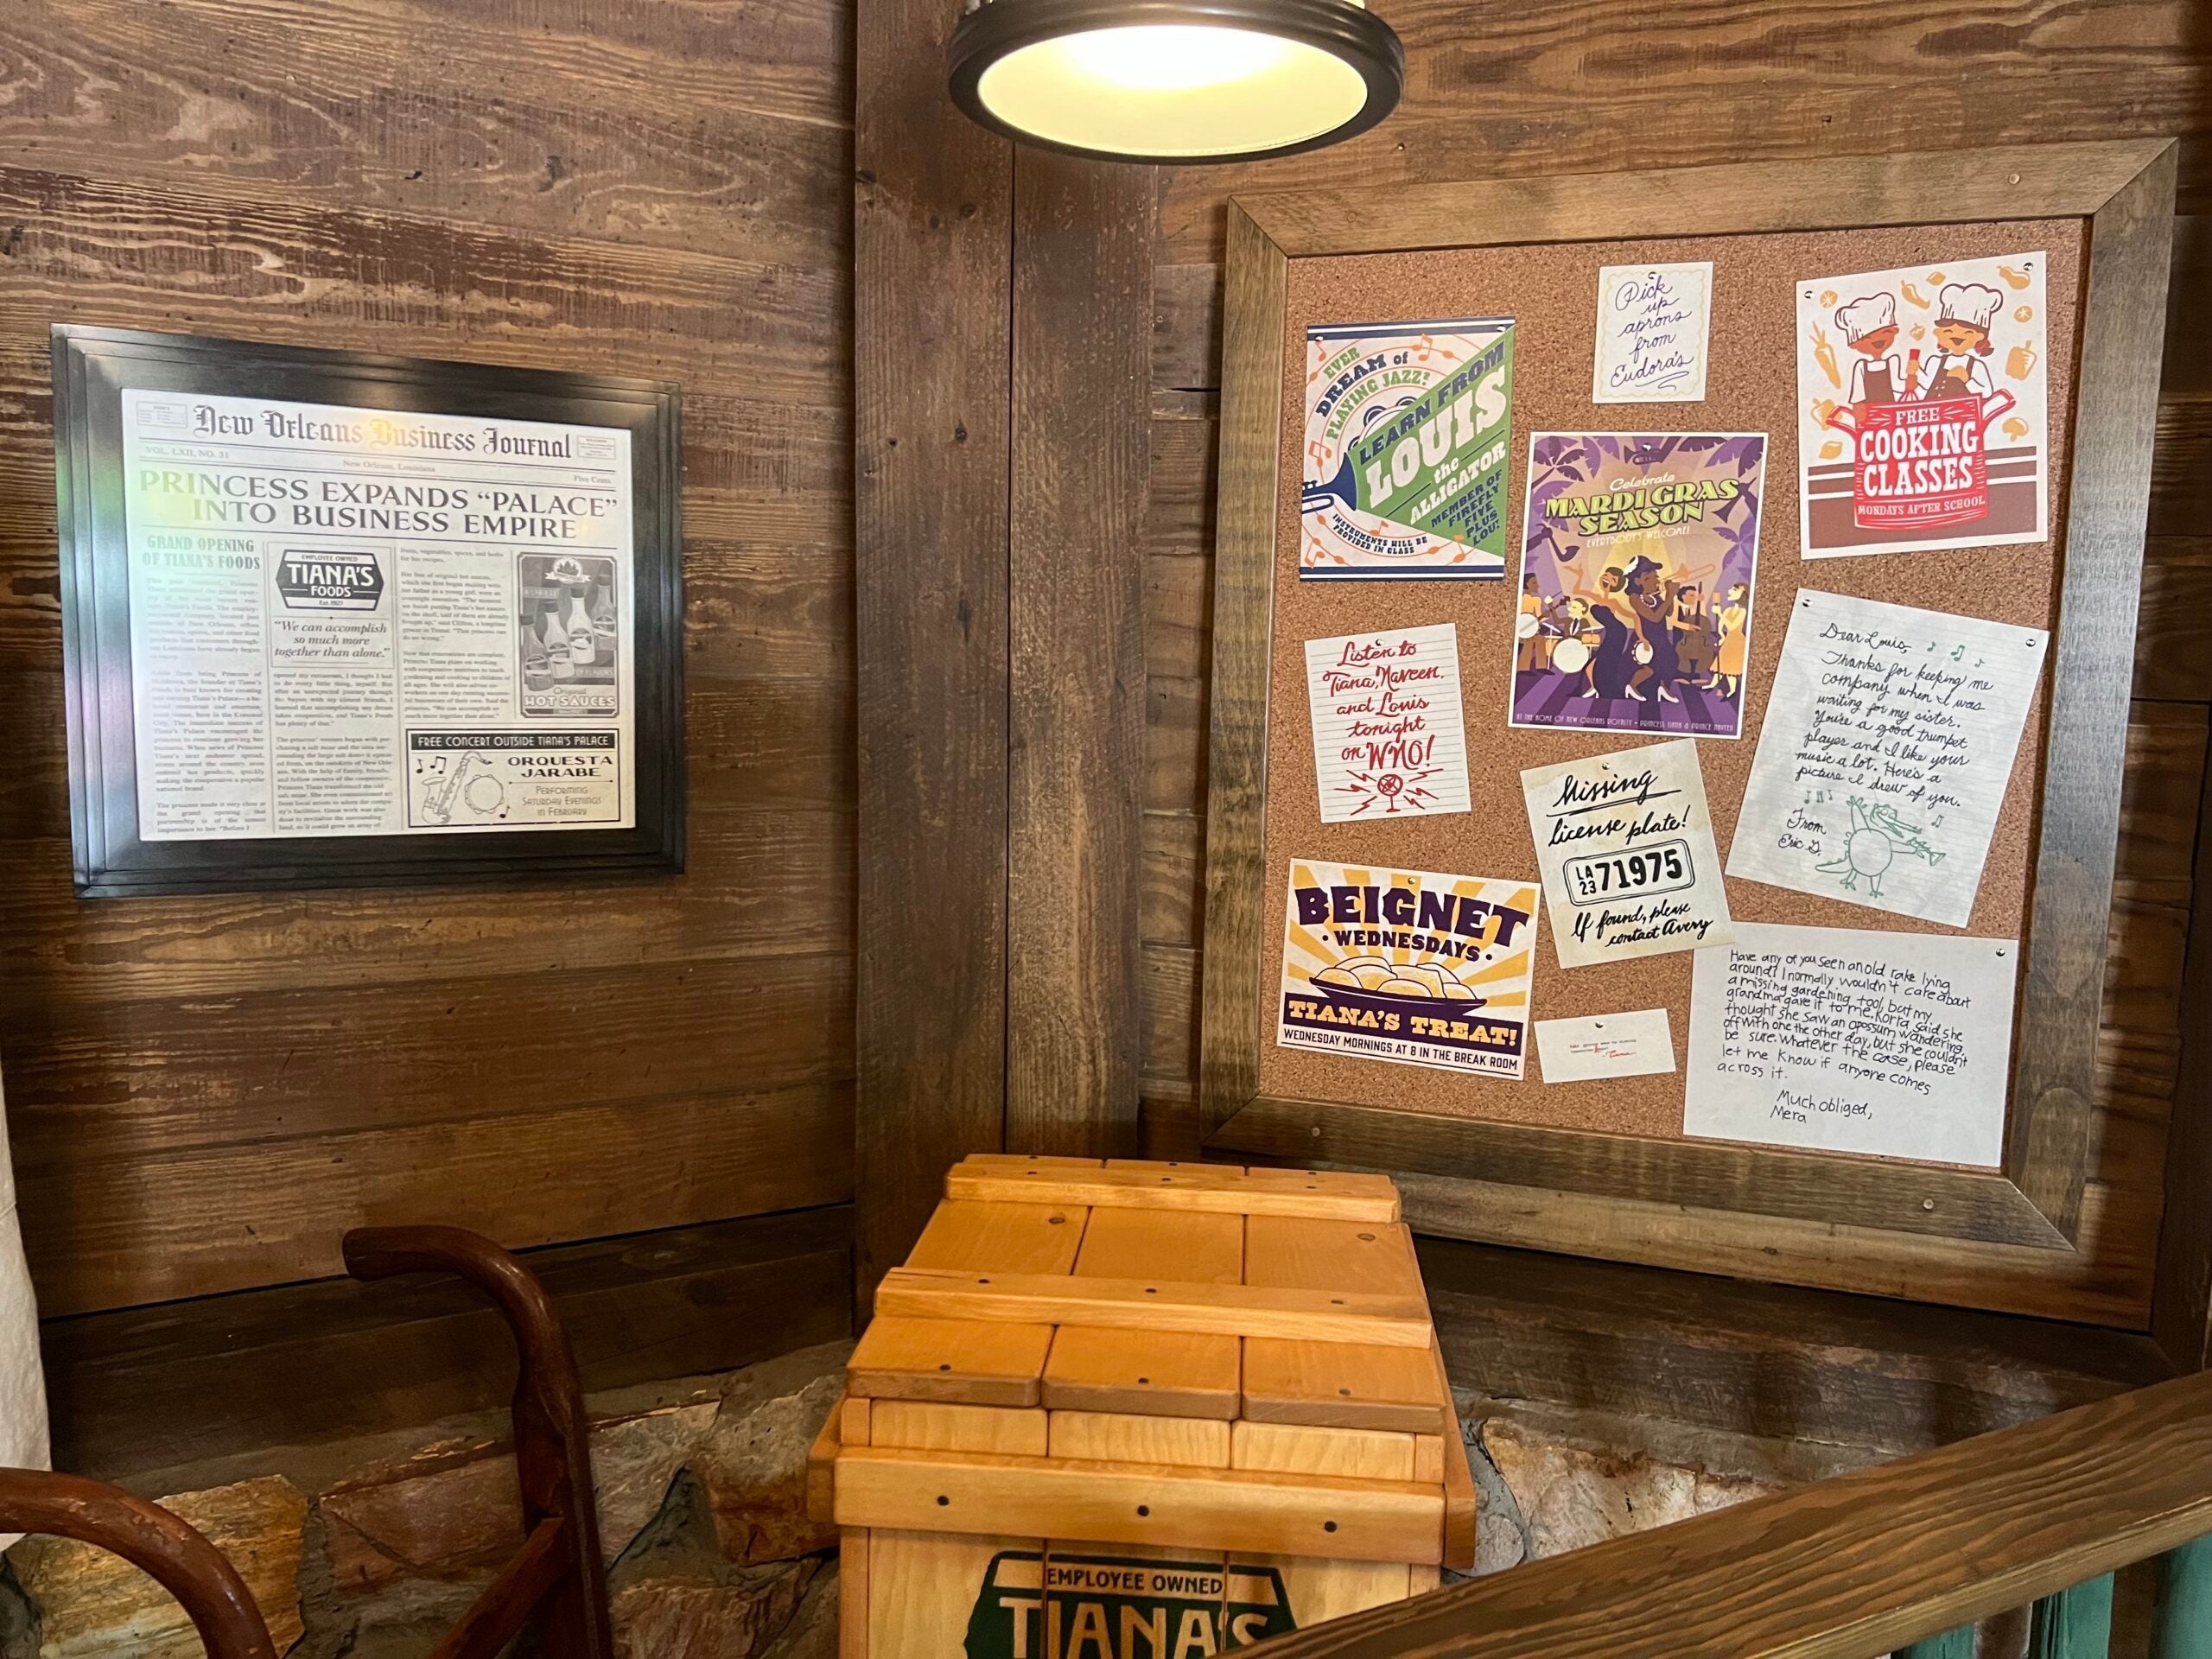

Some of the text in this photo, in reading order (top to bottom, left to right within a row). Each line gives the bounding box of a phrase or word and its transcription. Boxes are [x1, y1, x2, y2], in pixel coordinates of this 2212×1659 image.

[1615, 275, 1672, 311] Pick
[1641, 297, 1681, 316] up
[1618, 311, 1692, 340] aprons
[1323, 346, 1360, 378] EVER
[1629, 334, 1676, 364] from
[1315, 352, 1408, 417] DREAM of
[1611, 351, 1694, 388] Eudora's
[1325, 370, 1431, 441] PLAYING JAZZ?
[1359, 341, 1504, 465] LEARN FROM
[1895, 407, 1940, 426] FREE
[194, 404, 254, 439] New
[261, 410, 363, 443] Orleans
[369, 418, 475, 451] Business
[483, 427, 571, 459] Journal
[1365, 365, 1507, 509] LOUIS
[1859, 420, 1980, 463] COOKING
[342, 460, 360, 469] New
[398, 462, 435, 473] Louisiana
[1433, 457, 1459, 484] the
[1863, 456, 1974, 498] CLASSES
[139, 470, 308, 500] PRINCESS
[322, 481, 468, 509] EXPANDS
[1410, 442, 1505, 524] ALLIGATOR
[1609, 473, 1675, 492] Celebrate
[1431, 470, 1503, 528] MEMBER OF
[1448, 486, 1500, 527] FIREFLY
[1465, 500, 1494, 528] FIVE
[1545, 479, 1739, 519] MARDI GRAS
[1858, 495, 1986, 516] MONDAYS AFTER SCHOOL
[193, 499, 577, 538] INTO BUSINESS EMPIRE
[1332, 513, 1389, 547] INSTRUMENTS
[1416, 536, 1427, 545] BE
[1466, 511, 1498, 538] PLUS
[1578, 502, 1704, 536] SEASON
[147, 535, 254, 553] GRAND OPENING
[1332, 524, 1414, 555] PROVIDED IN CLASS
[1472, 522, 1501, 546] LOU!
[142, 552, 261, 569] OF TIANA'S FOODS
[286, 563, 374, 587] TIANA'S
[311, 586, 352, 597] FOODS
[308, 635, 339, 645] much
[342, 637, 370, 645] more
[325, 623, 387, 635] accomplish
[1820, 622, 1911, 654] Dear Louis,
[275, 646, 321, 658] together
[323, 647, 350, 658] than
[1337, 639, 1416, 668] Listen to
[1322, 671, 1379, 697] Tiana,
[1821, 651, 1994, 693] Thanks for keeping me
[524, 695, 615, 708] HOT SAUCES
[1337, 692, 1429, 717] and Louis
[1821, 673, 1986, 711] company when I was
[417, 735, 609, 747] FREE CONCERT OUTSIDE TIANA'S PALACE
[1345, 715, 1426, 743] tonight
[507, 756, 613, 766] ORQUESTA
[1341, 734, 1435, 771] on WNO!
[521, 767, 601, 778] JARABE
[1552, 770, 1658, 805] Missing
[1548, 804, 1691, 847] license plate!
[1787, 808, 1827, 835] From
[1576, 865, 1593, 880] LA
[1595, 849, 1683, 891] 71975
[1580, 880, 1597, 895] 23
[1295, 886, 1529, 949] BEIGNET
[1571, 899, 1691, 943] If found, please
[1333, 930, 1480, 963] WEDNESDAYS
[1605, 918, 1713, 948] contact Avery
[1730, 949, 1757, 963] Have
[1761, 954, 1781, 966] any
[1785, 954, 1798, 964] of
[1799, 956, 1817, 967] you
[1847, 962, 1863, 973] an
[1864, 961, 1885, 976] old
[1891, 969, 1916, 982] rake
[1923, 972, 1950, 995] lying
[1289, 1001, 1518, 1046] TIANA'S TREAT!
[1283, 1028, 1518, 1070] WEDNESDAY MORNINGS AT 8 IN THE BREAK ROOM
[1717, 1063, 1788, 1079] across it.
[1770, 1105, 1807, 1123] Mera
[1777, 1089, 1872, 1120] Much obliged,
[1046, 1567, 1223, 1595] EMPLOYEE OWNED
